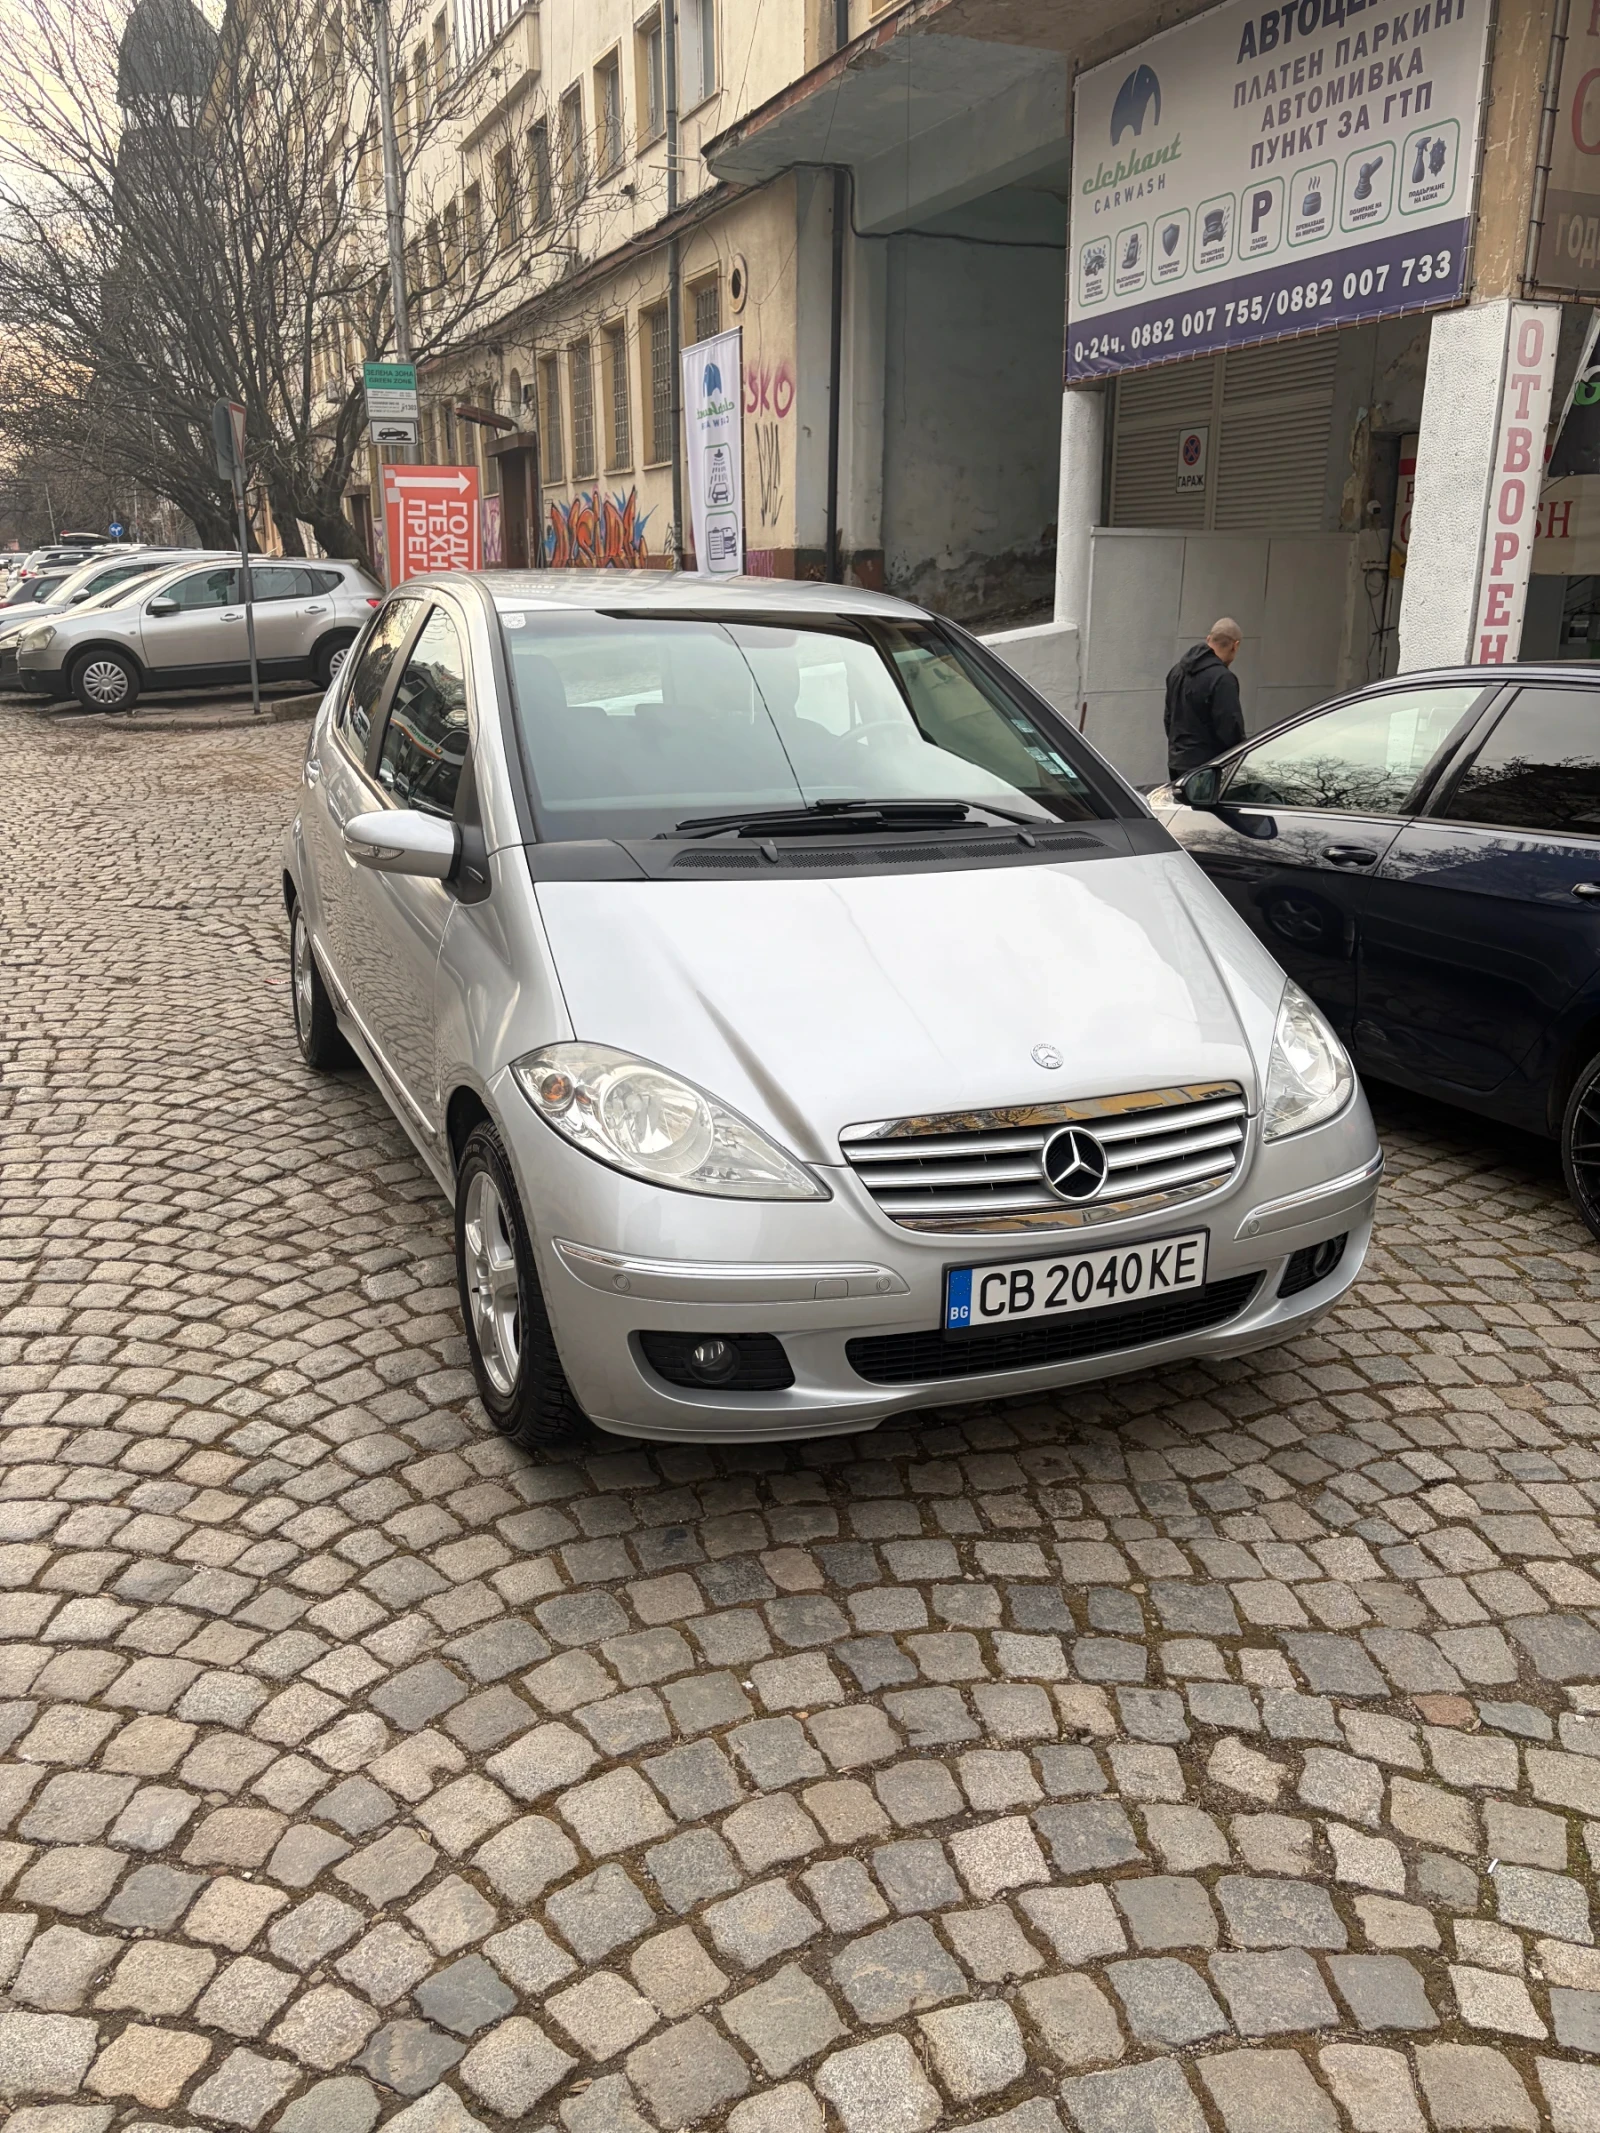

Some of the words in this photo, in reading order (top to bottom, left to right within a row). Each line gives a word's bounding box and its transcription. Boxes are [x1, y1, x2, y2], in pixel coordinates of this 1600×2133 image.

[1236, 0, 1387, 64] АВТОЦ
[1233, 49, 1324, 109] ПЛАТЕН
[1261, 47, 1424, 132] АВТОМИВКА
[1250, 118, 1328, 170] ПУНКТ
[1337, 103, 1371, 139] ЗА
[1383, 80, 1433, 125] ГТП
[1082, 132, 1182, 195] elephant
[1094, 173, 1167, 214] CARWASH
[1555, 213, 1600, 269] ГОД
[1074, 334, 1125, 362] 0-24ч.
[1131, 318, 1174, 349] 0882
[1182, 307, 1217, 337] 007
[1343, 264, 1390, 300] 007
[1402, 250, 1451, 287] 733
[366, 369, 393, 377] ЗЕЛЕНА
[1178, 474, 1204, 488] ГАРАЖ
[428, 499, 449, 573] ТЕХН
[980, 1269, 1034, 1317] CB
[1044, 1252, 1142, 1308] 2040
[1149, 1240, 1198, 1290] KE
[950, 1305, 969, 1321] BG
